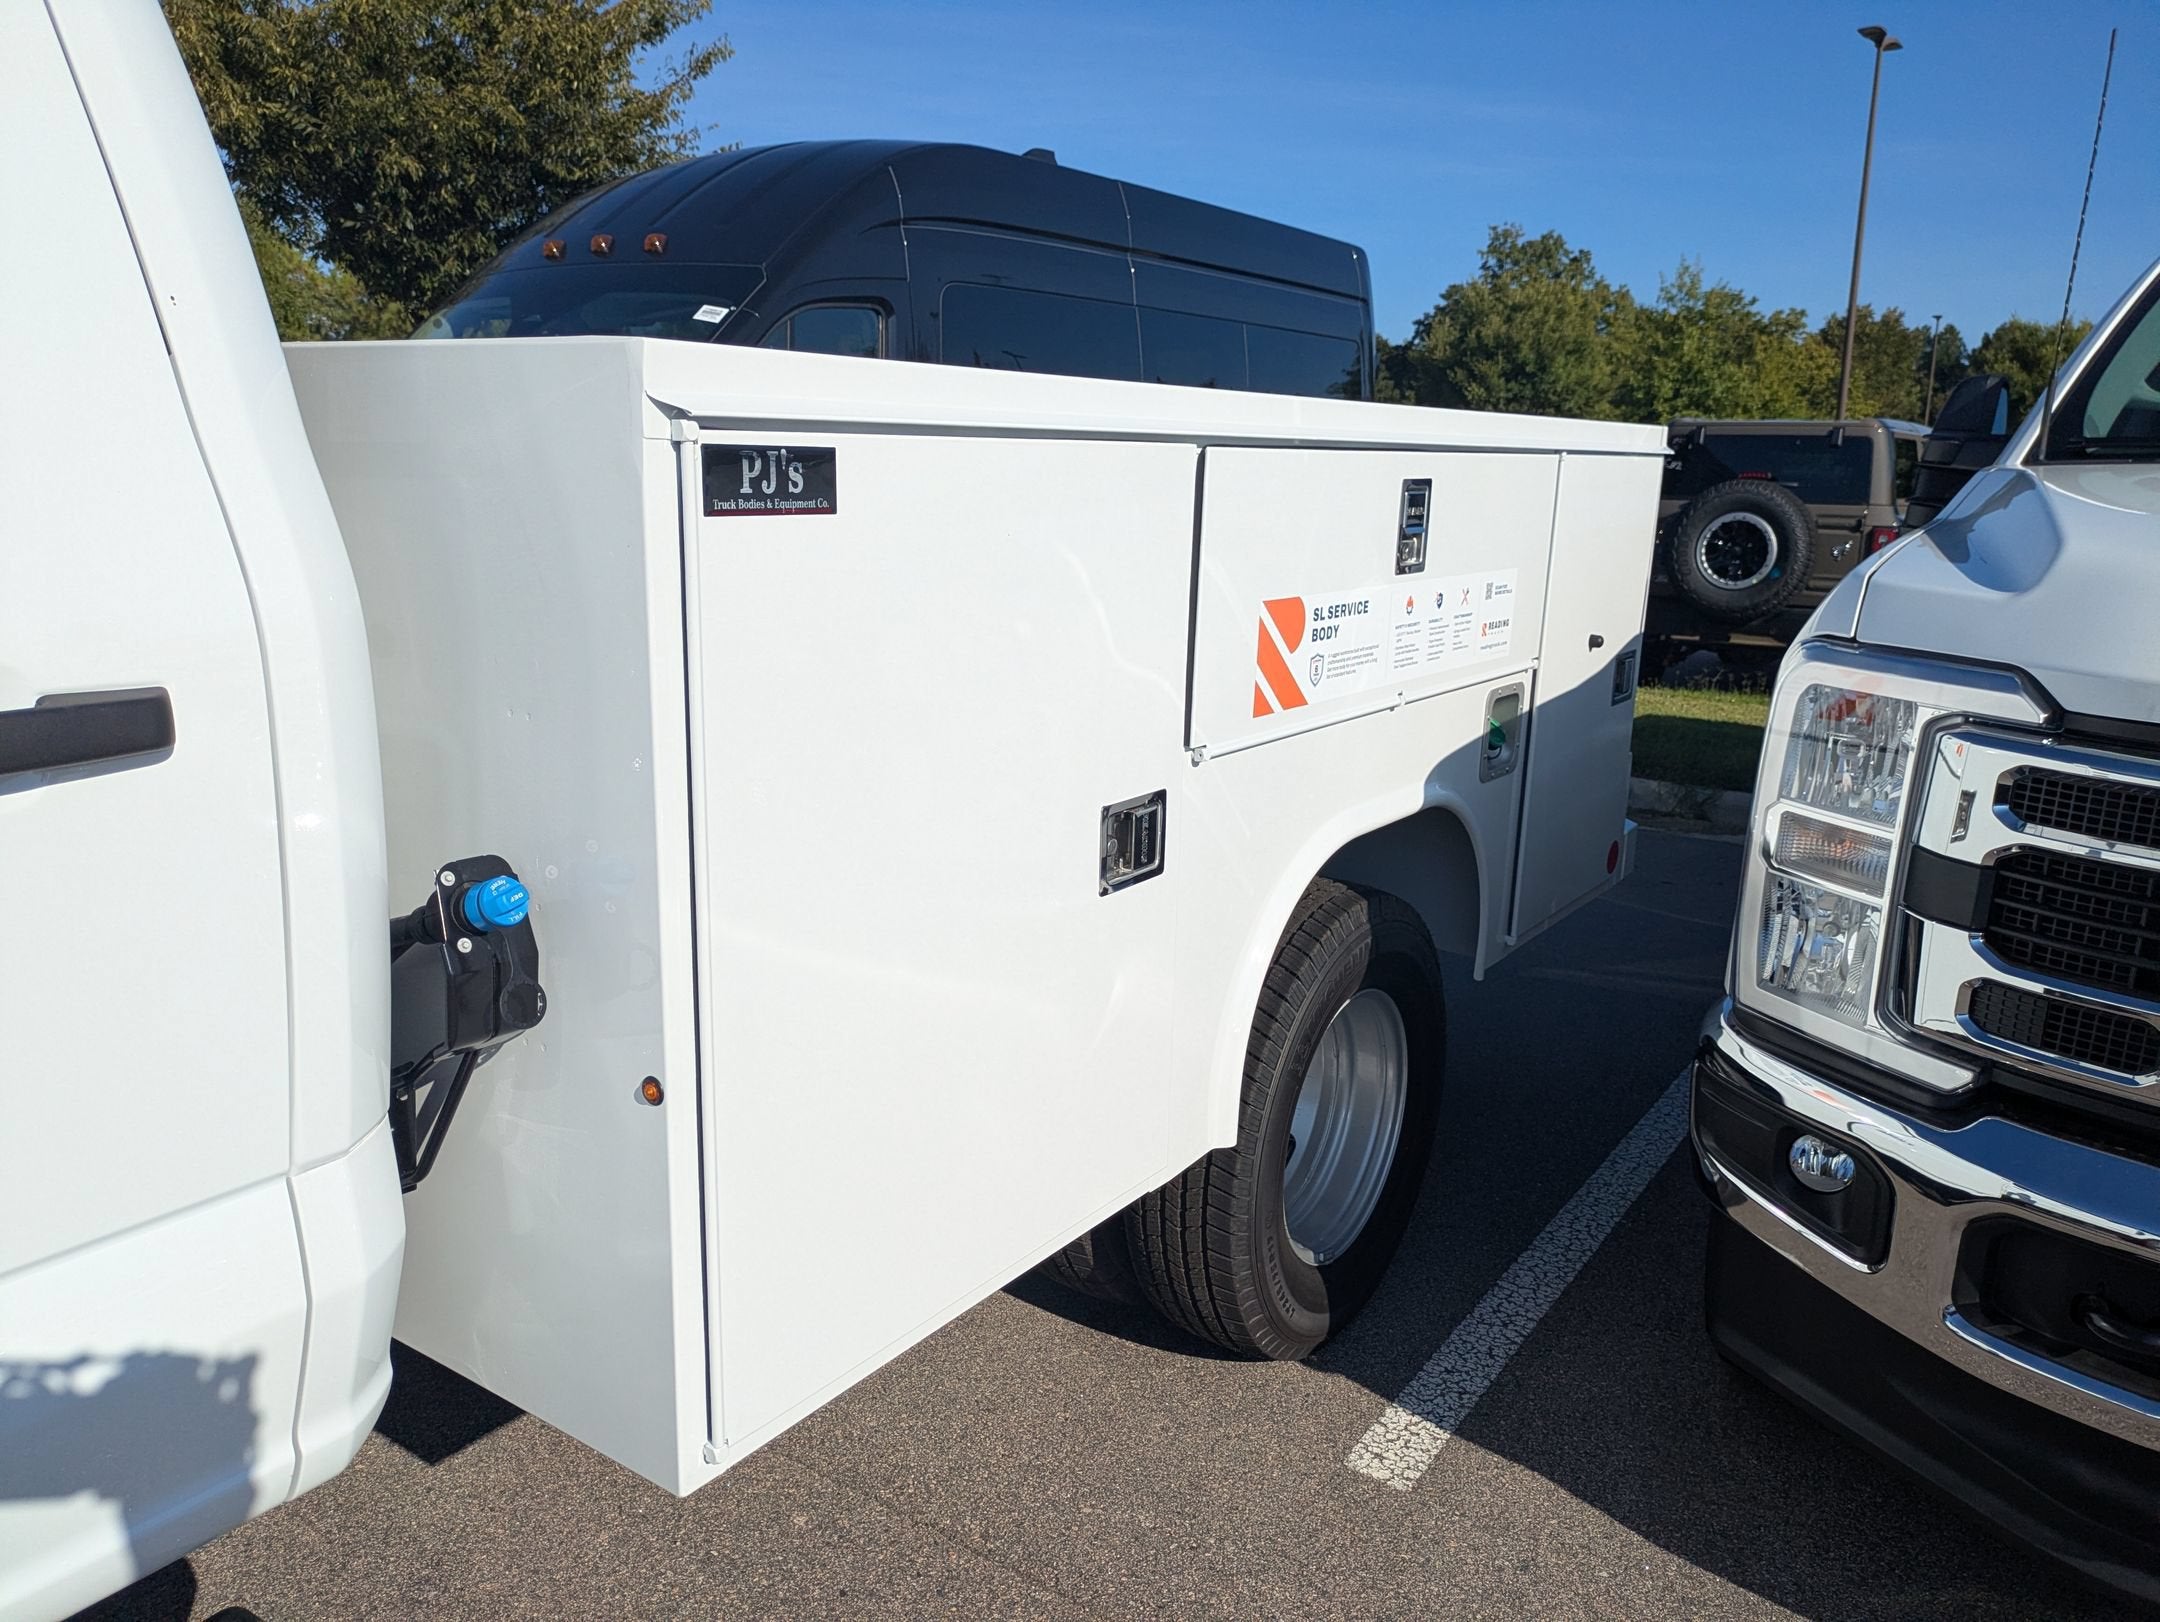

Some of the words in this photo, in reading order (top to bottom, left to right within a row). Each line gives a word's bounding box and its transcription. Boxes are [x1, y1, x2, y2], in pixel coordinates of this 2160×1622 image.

[739, 448, 804, 495] PJ's
[713, 499, 737, 510] Truck
[738, 498, 765, 510] Bodies
[766, 499, 773, 509] &
[774, 498, 816, 514] Equipment
[817, 498, 830, 508] Co.
[1313, 607, 1326, 622] SL
[1327, 600, 1370, 620] SERVICE
[1488, 618, 1510, 631] READING
[1311, 624, 1340, 643] BODY
[510, 891, 524, 903] DEF
